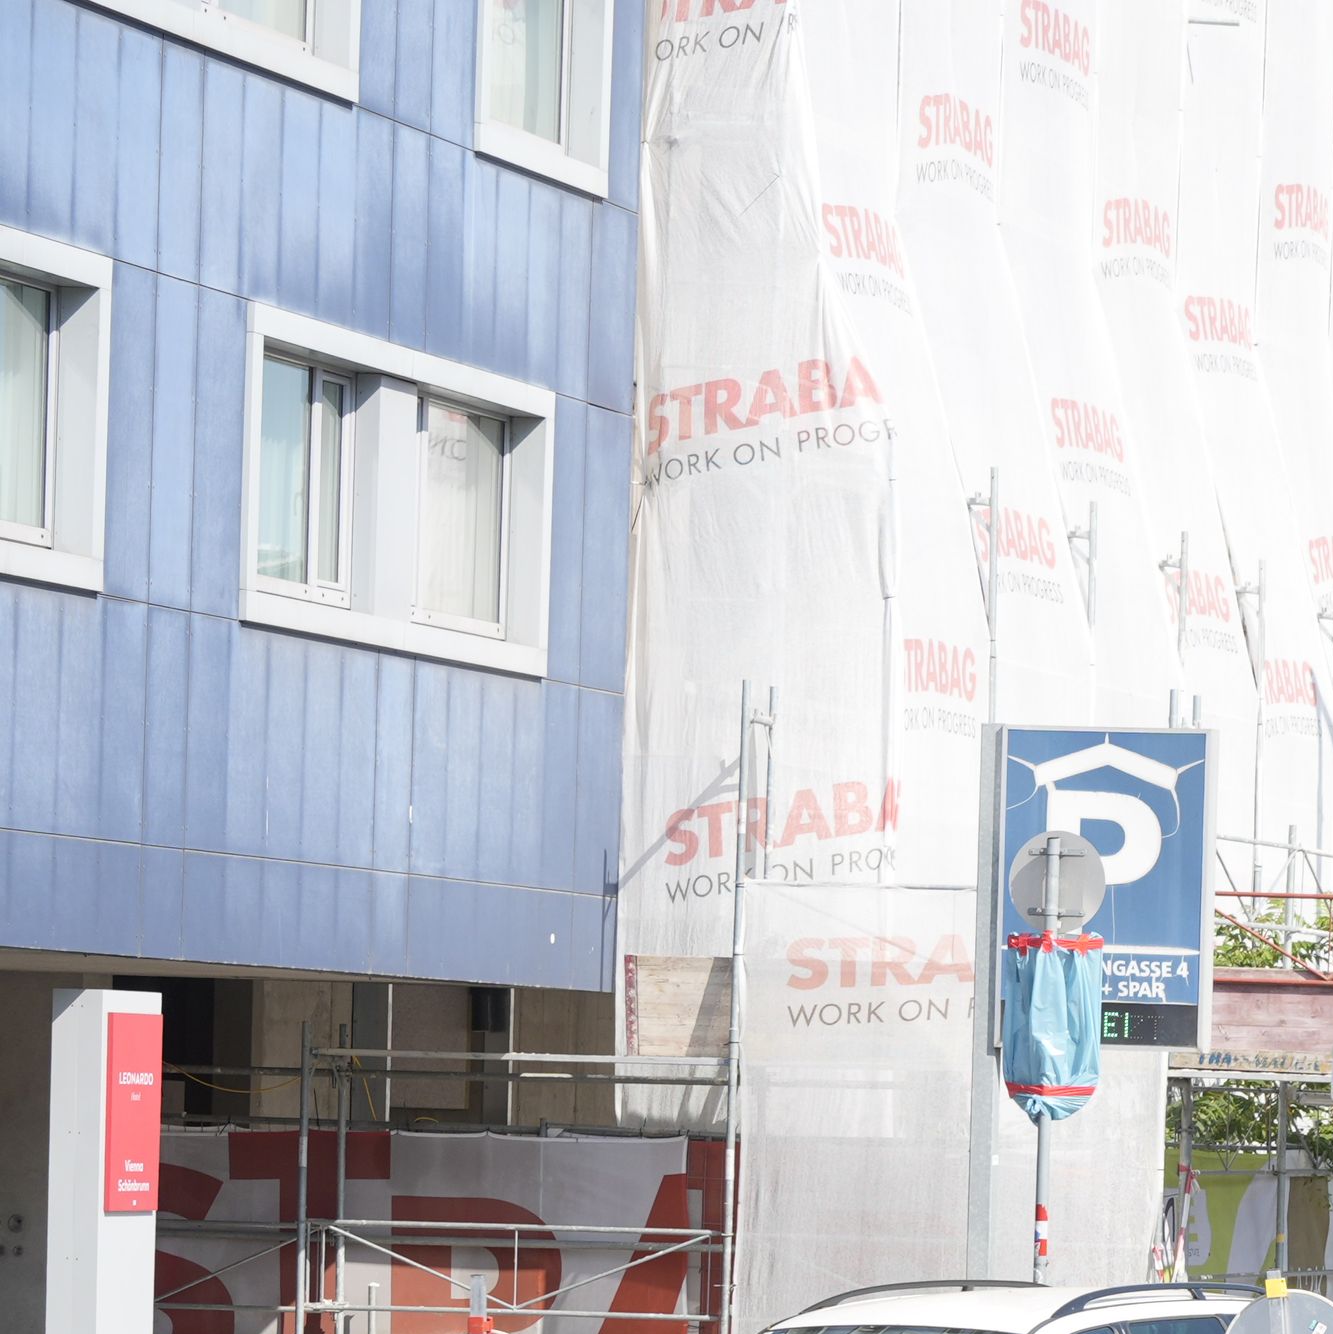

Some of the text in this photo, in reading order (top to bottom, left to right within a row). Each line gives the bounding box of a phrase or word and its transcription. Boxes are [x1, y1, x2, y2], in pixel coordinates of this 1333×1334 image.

[654, 21, 766, 61] ORK ON
[1019, 0, 1091, 77] STRABAG
[1019, 61, 1047, 88] WORK
[917, 92, 993, 168] STRABAG
[915, 159, 949, 184] WORK
[1102, 197, 1170, 259] STRABAG
[647, 356, 885, 456] STRABA
[1050, 396, 1125, 463] STRABAG
[733, 437, 782, 467] ON
[903, 638, 977, 703] TRABAG
[1264, 658, 1318, 708] RABAG
[903, 705, 977, 739] ORK ON PROGRESS
[1046, 788, 1162, 934] P
[785, 933, 976, 991] STRA
[1176, 962, 1190, 979] 4
[1117, 981, 1167, 999] SPAR
[787, 998, 950, 1028] WORK ON
[118, 1071, 154, 1087] LEONARDO
[124, 1159, 144, 1173] Vienna
[117, 1178, 150, 1193] Schönbrunn
